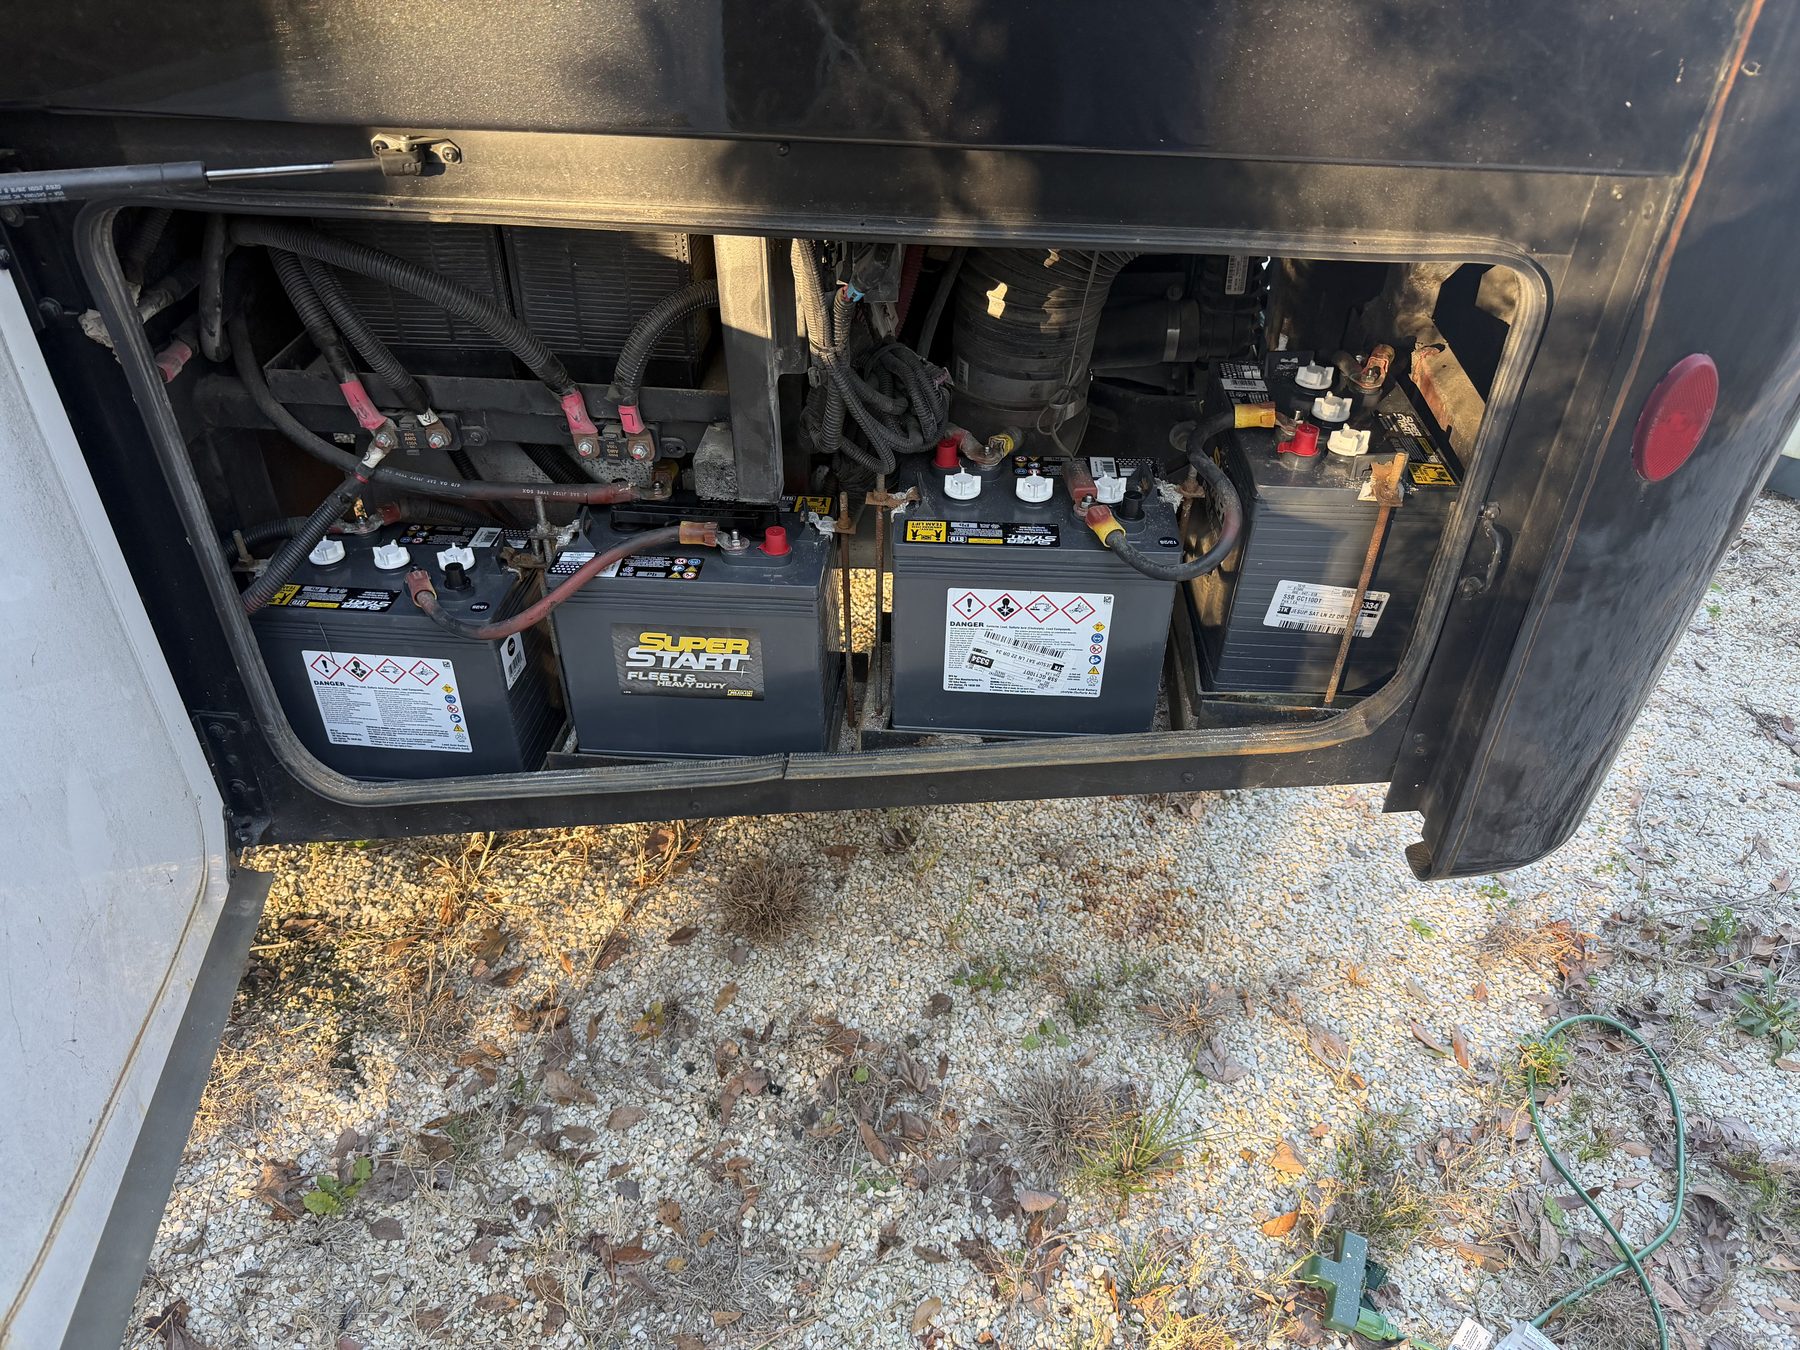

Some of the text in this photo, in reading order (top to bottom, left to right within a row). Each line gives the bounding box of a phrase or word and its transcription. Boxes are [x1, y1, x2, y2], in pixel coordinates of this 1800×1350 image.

[639, 632, 750, 654] SUPER
[626, 646, 751, 670] START
[972, 655, 990, 666] 5334
[627, 671, 698, 683] FLEET &
[656, 680, 694, 689] HEAVY
